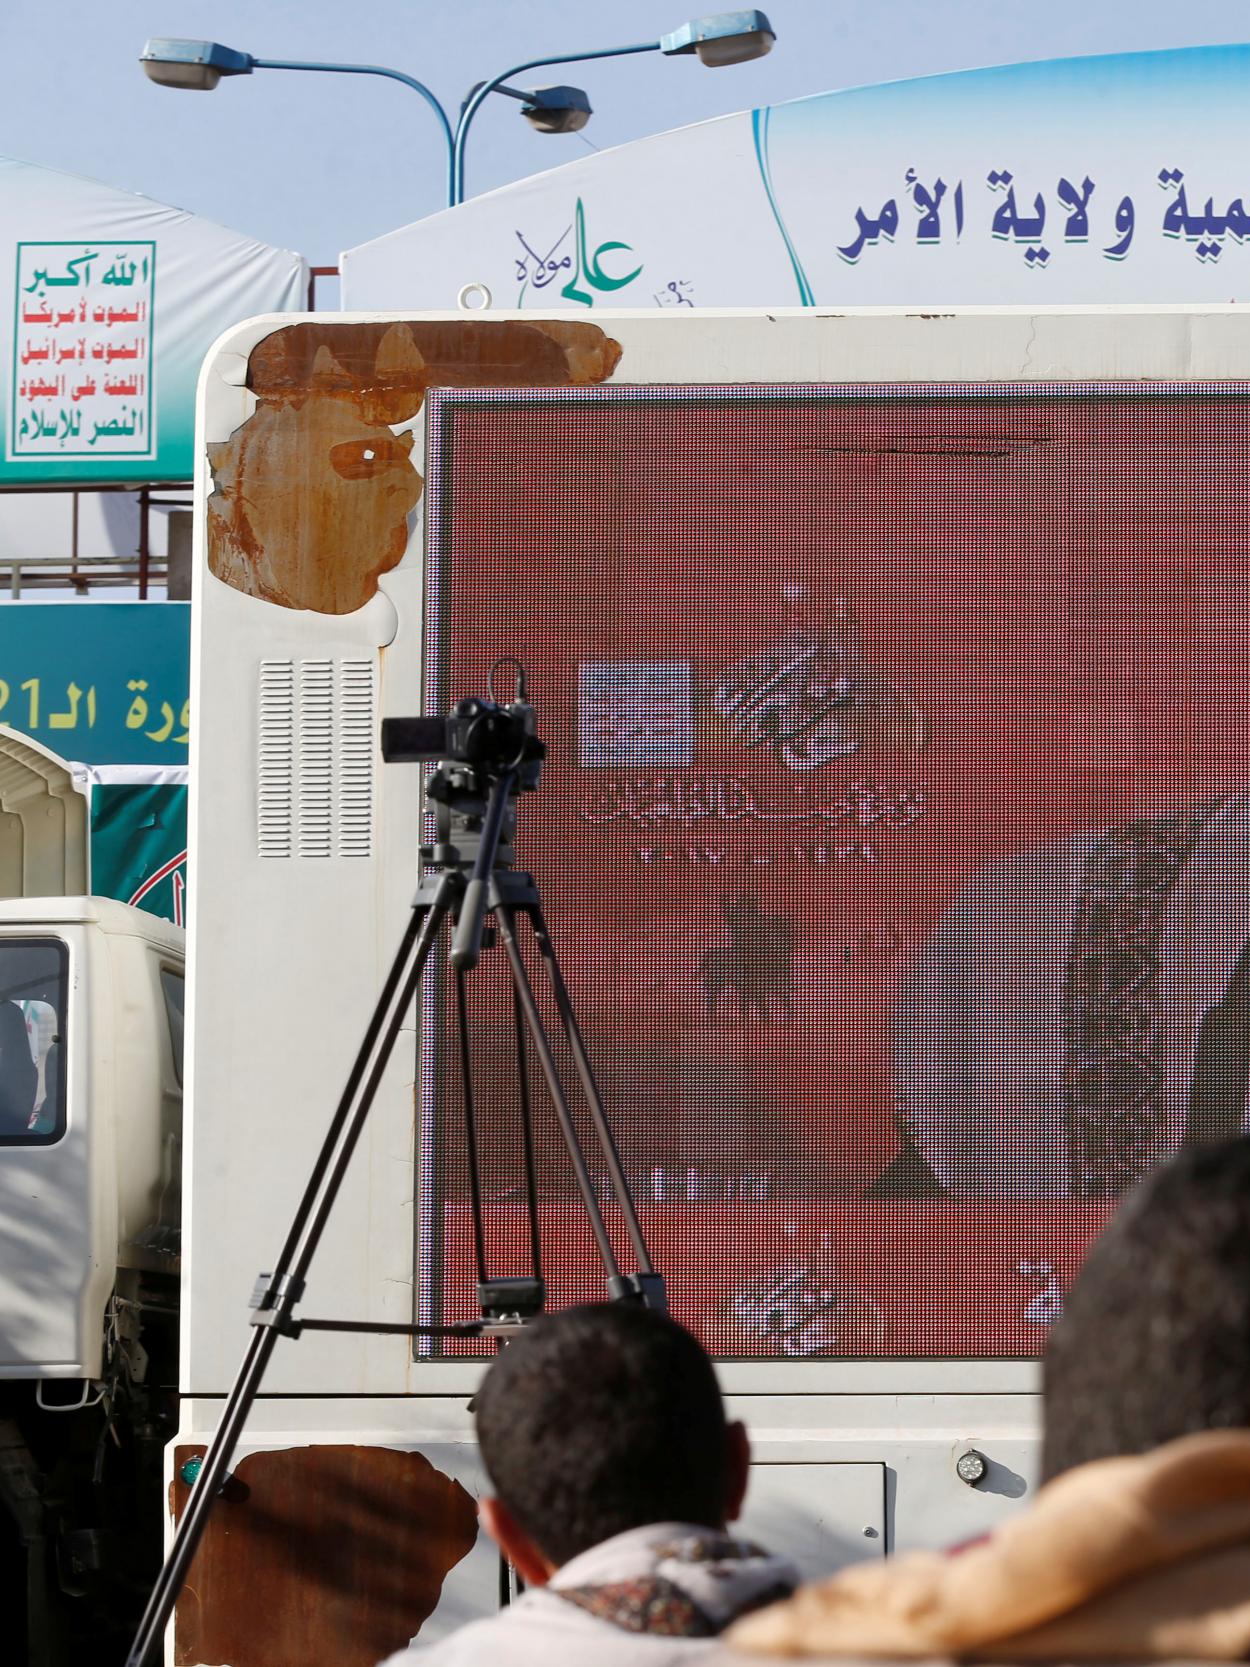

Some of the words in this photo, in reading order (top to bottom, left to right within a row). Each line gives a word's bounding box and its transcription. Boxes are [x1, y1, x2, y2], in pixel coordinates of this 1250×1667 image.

[836, 166, 964, 260] الأمر
[986, 168, 1135, 266] ولاية
[23, 247, 100, 299] أكبر
[101, 252, 149, 287] الله
[92, 300, 146, 328] الموت
[91, 337, 145, 365] الموت
[19, 374, 66, 402] اليهود
[103, 373, 145, 396] اللعنة
[87, 404, 144, 446] النصر
